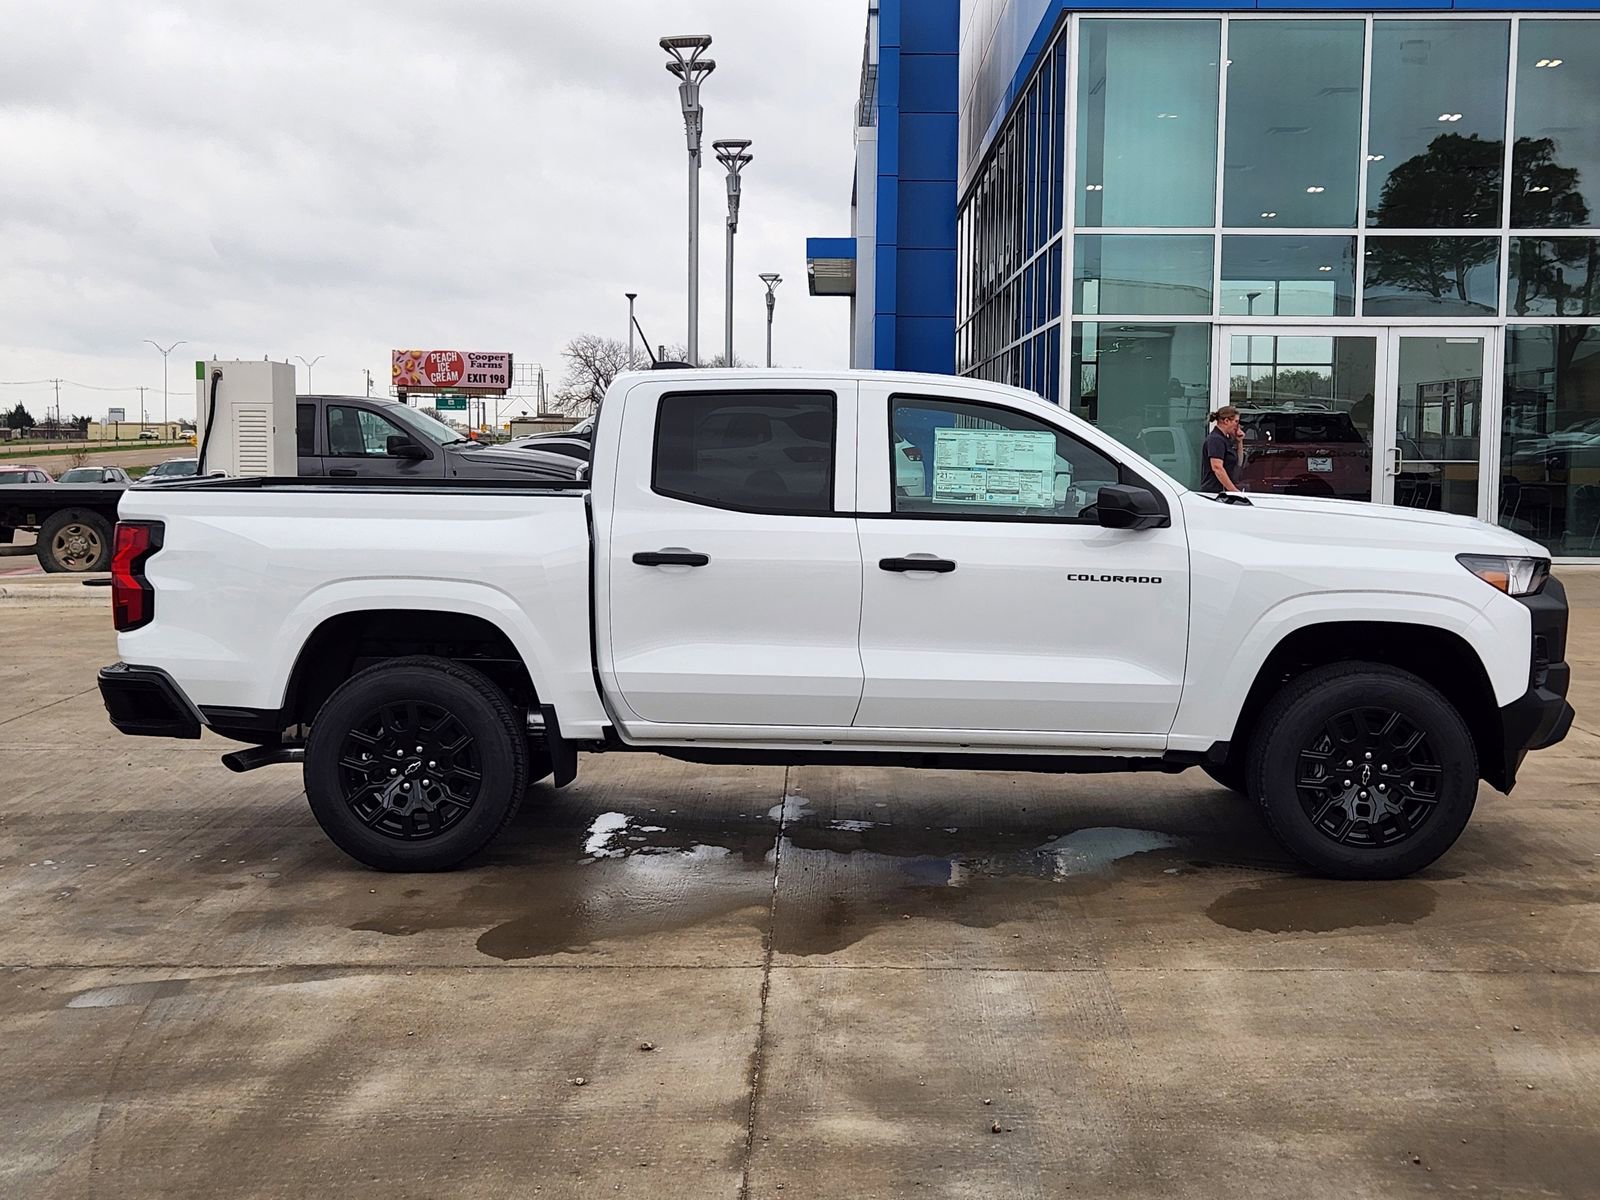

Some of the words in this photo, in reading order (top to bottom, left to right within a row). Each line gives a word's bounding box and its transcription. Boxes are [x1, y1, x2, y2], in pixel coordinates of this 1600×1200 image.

[431, 352, 457, 363] PEACH
[468, 353, 506, 362] Cooper
[437, 362, 450, 372] ICE
[470, 361, 503, 369] Farms
[431, 372, 458, 383] CREAM
[467, 374, 488, 383] EXIT
[489, 374, 505, 384] 198
[1067, 574, 1162, 584] COLORADO
